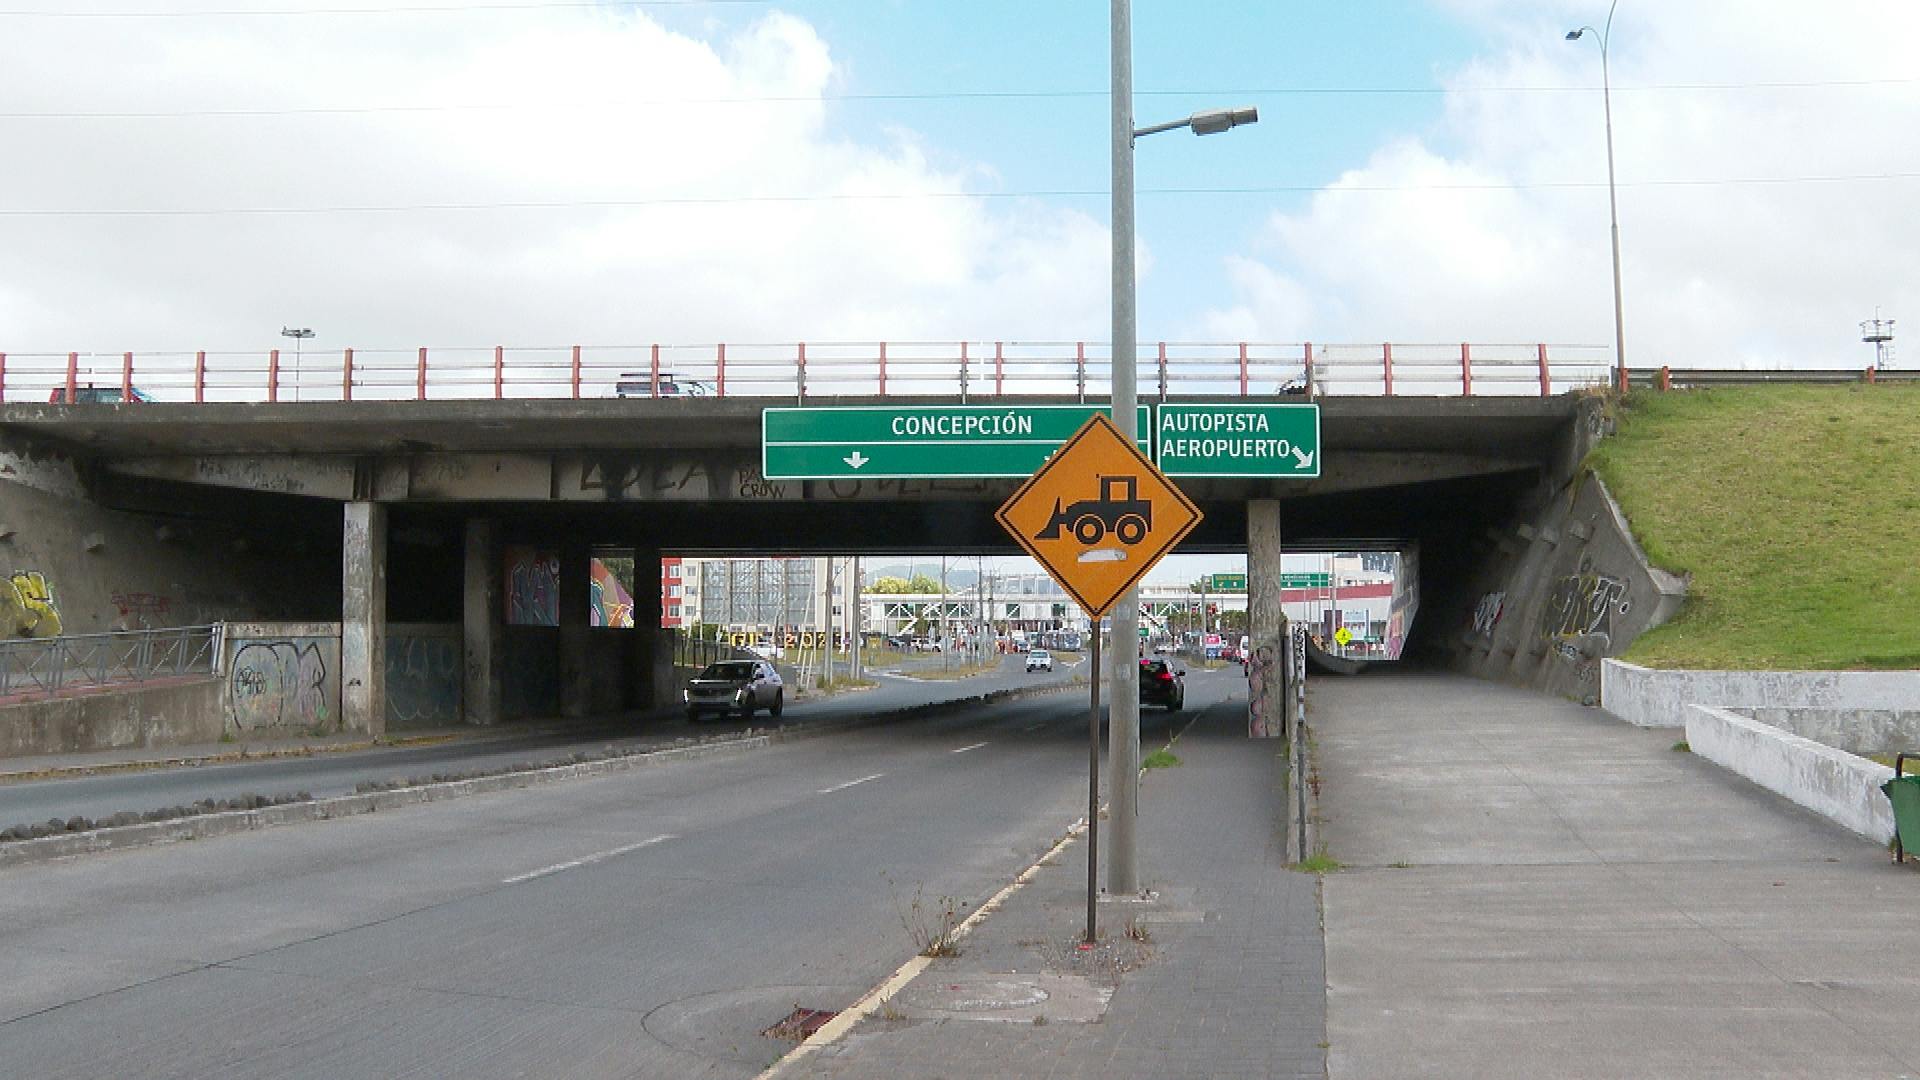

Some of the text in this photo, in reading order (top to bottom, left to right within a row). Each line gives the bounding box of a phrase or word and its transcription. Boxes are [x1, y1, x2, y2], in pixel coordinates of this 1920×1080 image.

[891, 410, 1032, 435] CONCEPCIÓN
[1162, 413, 1269, 432] AUTOPISTA
[1161, 439, 1290, 457] AEROPUERTO
